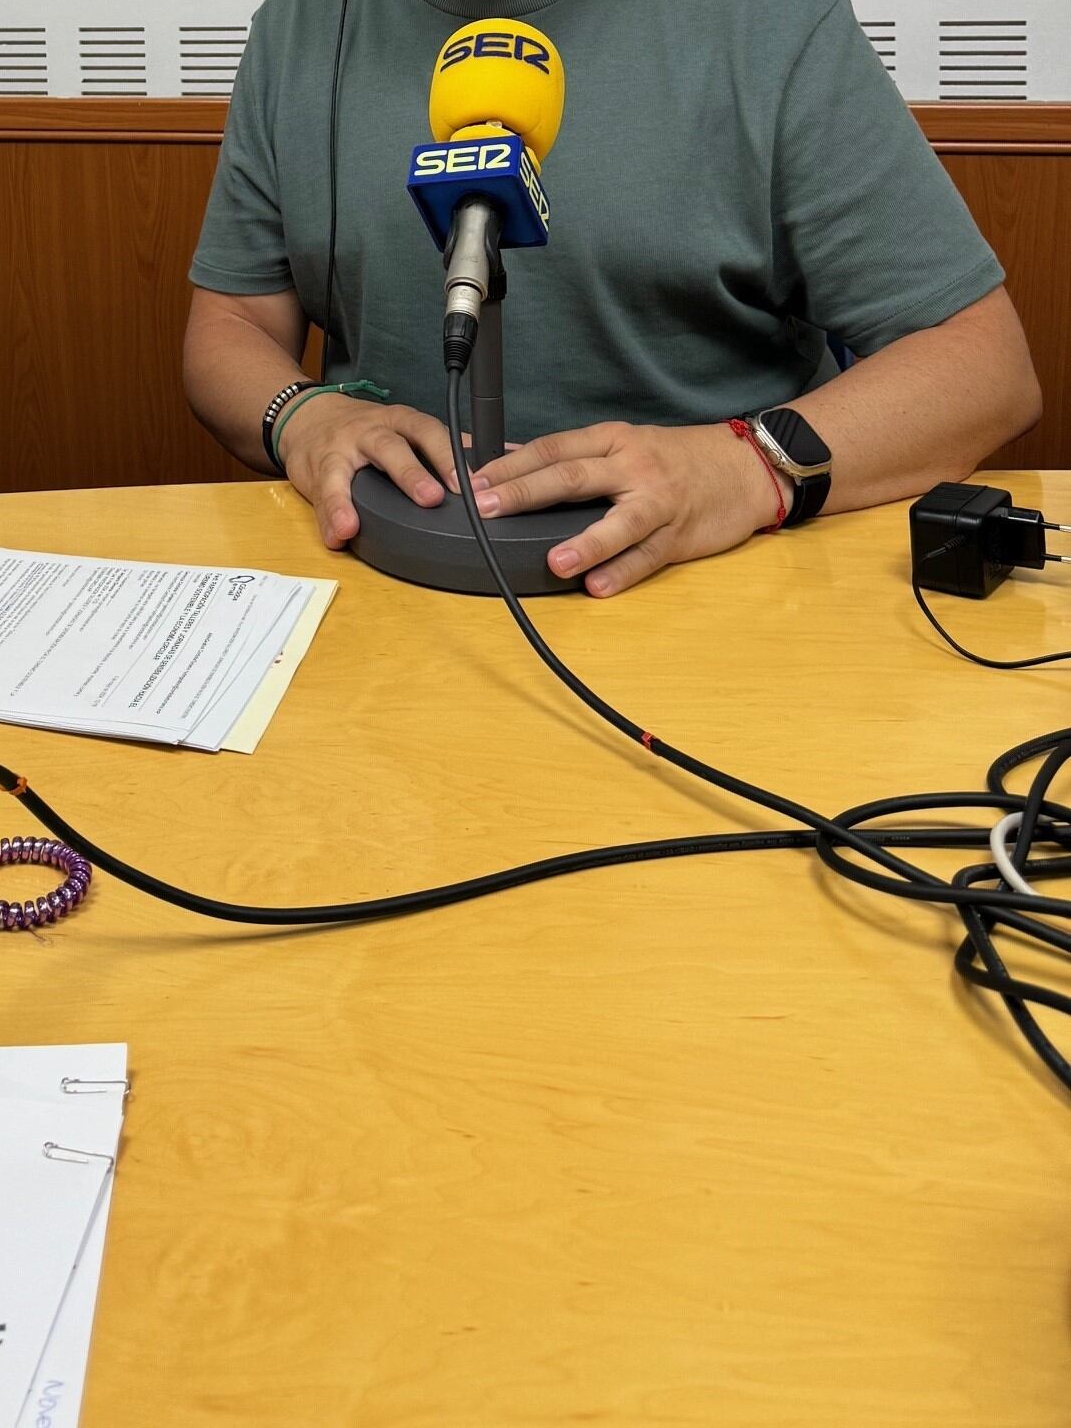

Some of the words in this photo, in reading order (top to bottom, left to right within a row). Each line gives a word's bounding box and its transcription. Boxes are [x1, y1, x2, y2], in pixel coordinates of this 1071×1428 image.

[440, 32, 550, 74] SER
[414, 144, 511, 176] SER
[519, 152, 550, 232] SER
